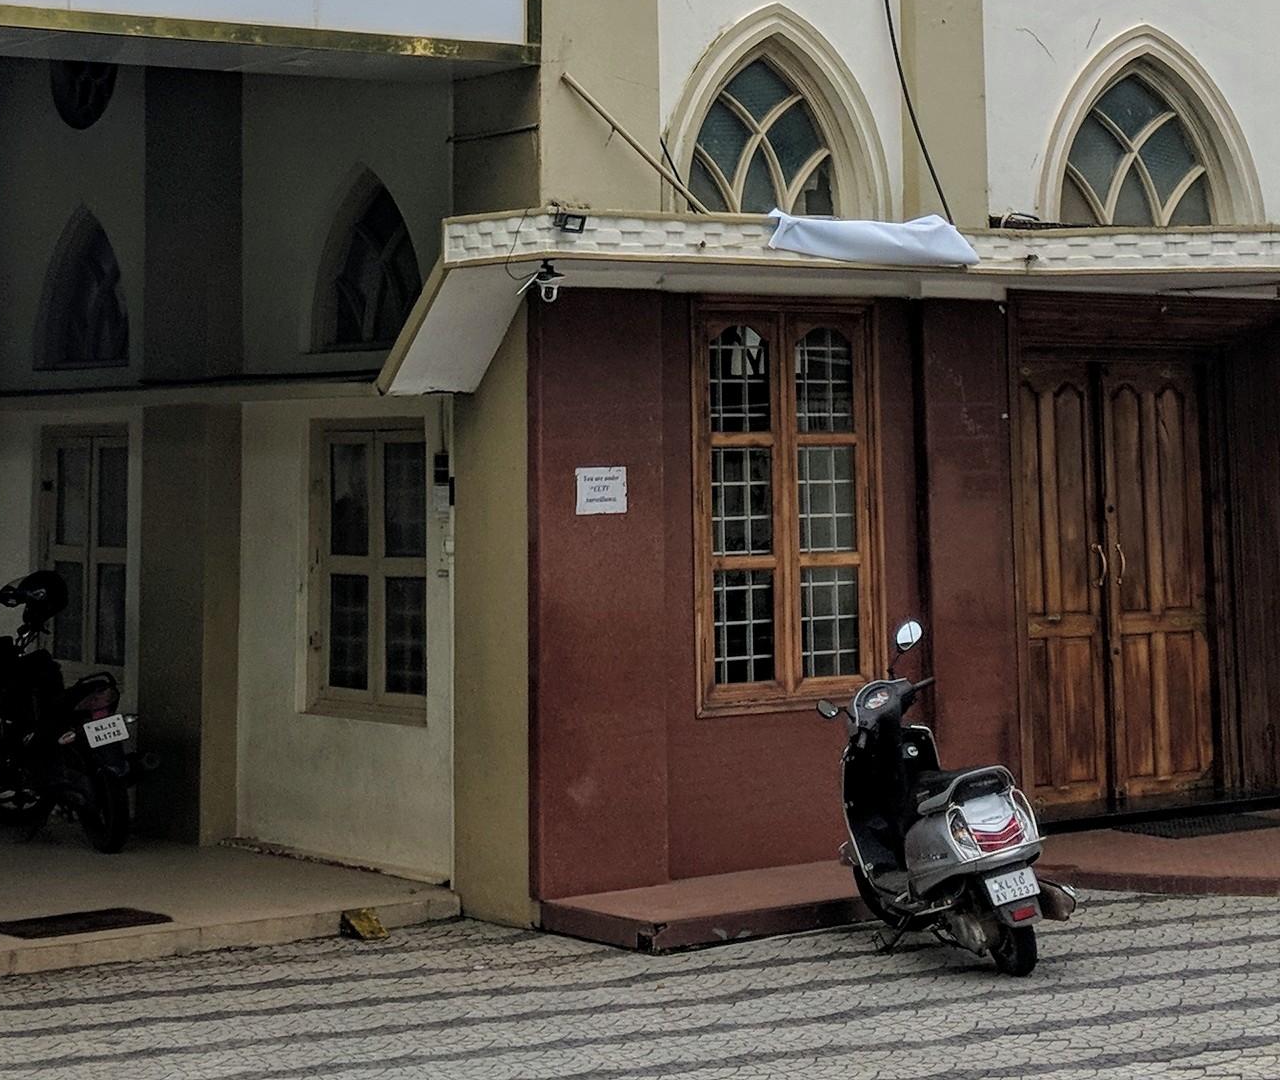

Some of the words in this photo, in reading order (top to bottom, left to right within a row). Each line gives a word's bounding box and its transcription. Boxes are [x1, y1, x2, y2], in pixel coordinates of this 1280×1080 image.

[996, 891, 1008, 903] AV
[1011, 883, 1035, 898] 2237
[998, 879, 1011, 891] KL
